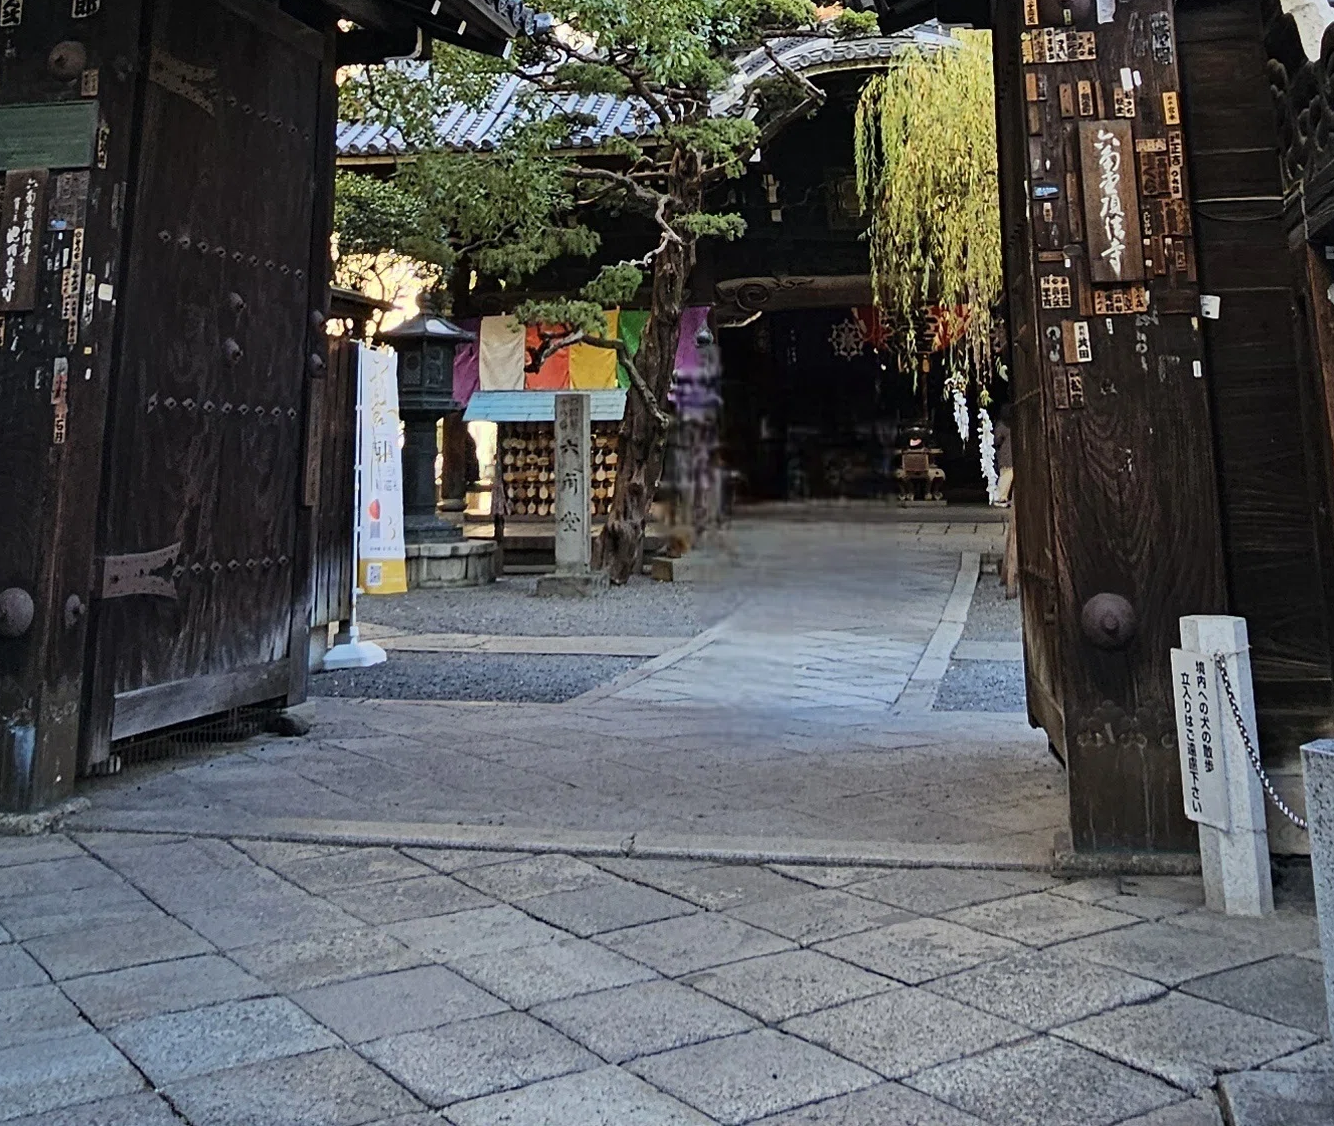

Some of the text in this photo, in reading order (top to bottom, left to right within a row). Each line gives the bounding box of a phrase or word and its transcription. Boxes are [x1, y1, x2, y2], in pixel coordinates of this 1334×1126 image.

[560, 439, 581, 533] 六角堂
[1195, 660, 1214, 773] 境内への犬の散歩
